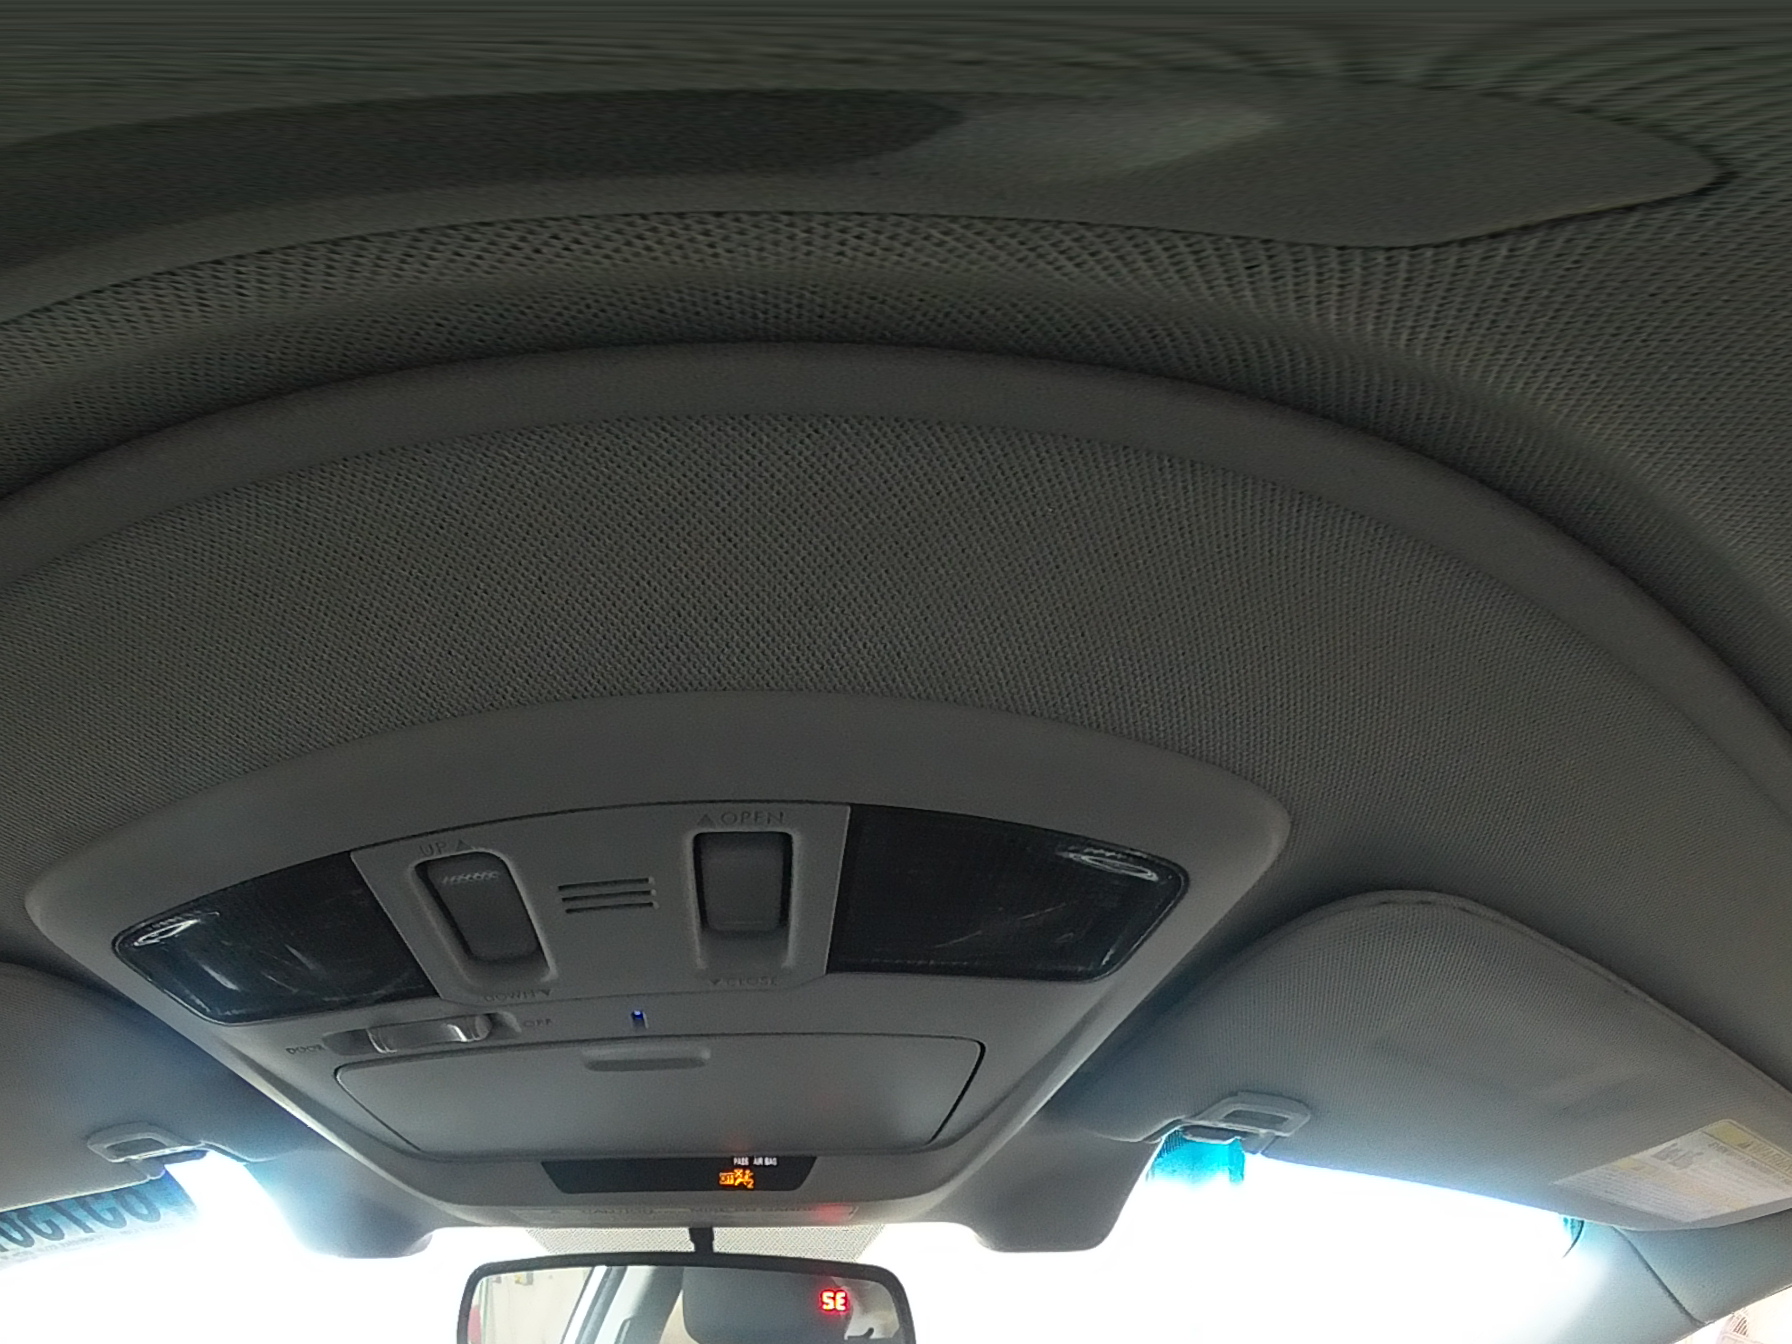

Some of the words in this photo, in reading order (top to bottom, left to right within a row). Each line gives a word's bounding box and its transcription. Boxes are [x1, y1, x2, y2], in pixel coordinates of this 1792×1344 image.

[721, 811, 784, 825] OPEN
[419, 842, 447, 857] UP
[726, 977, 777, 987] CLOSE
[484, 989, 536, 1002] DOWN
[524, 1018, 552, 1028] OFF
[285, 1044, 323, 1055] DOOR
[733, 1157, 749, 1166] PASS
[753, 1157, 763, 1166] AIR
[764, 1157, 777, 1166] BAG
[822, 1291, 846, 1311] SE
